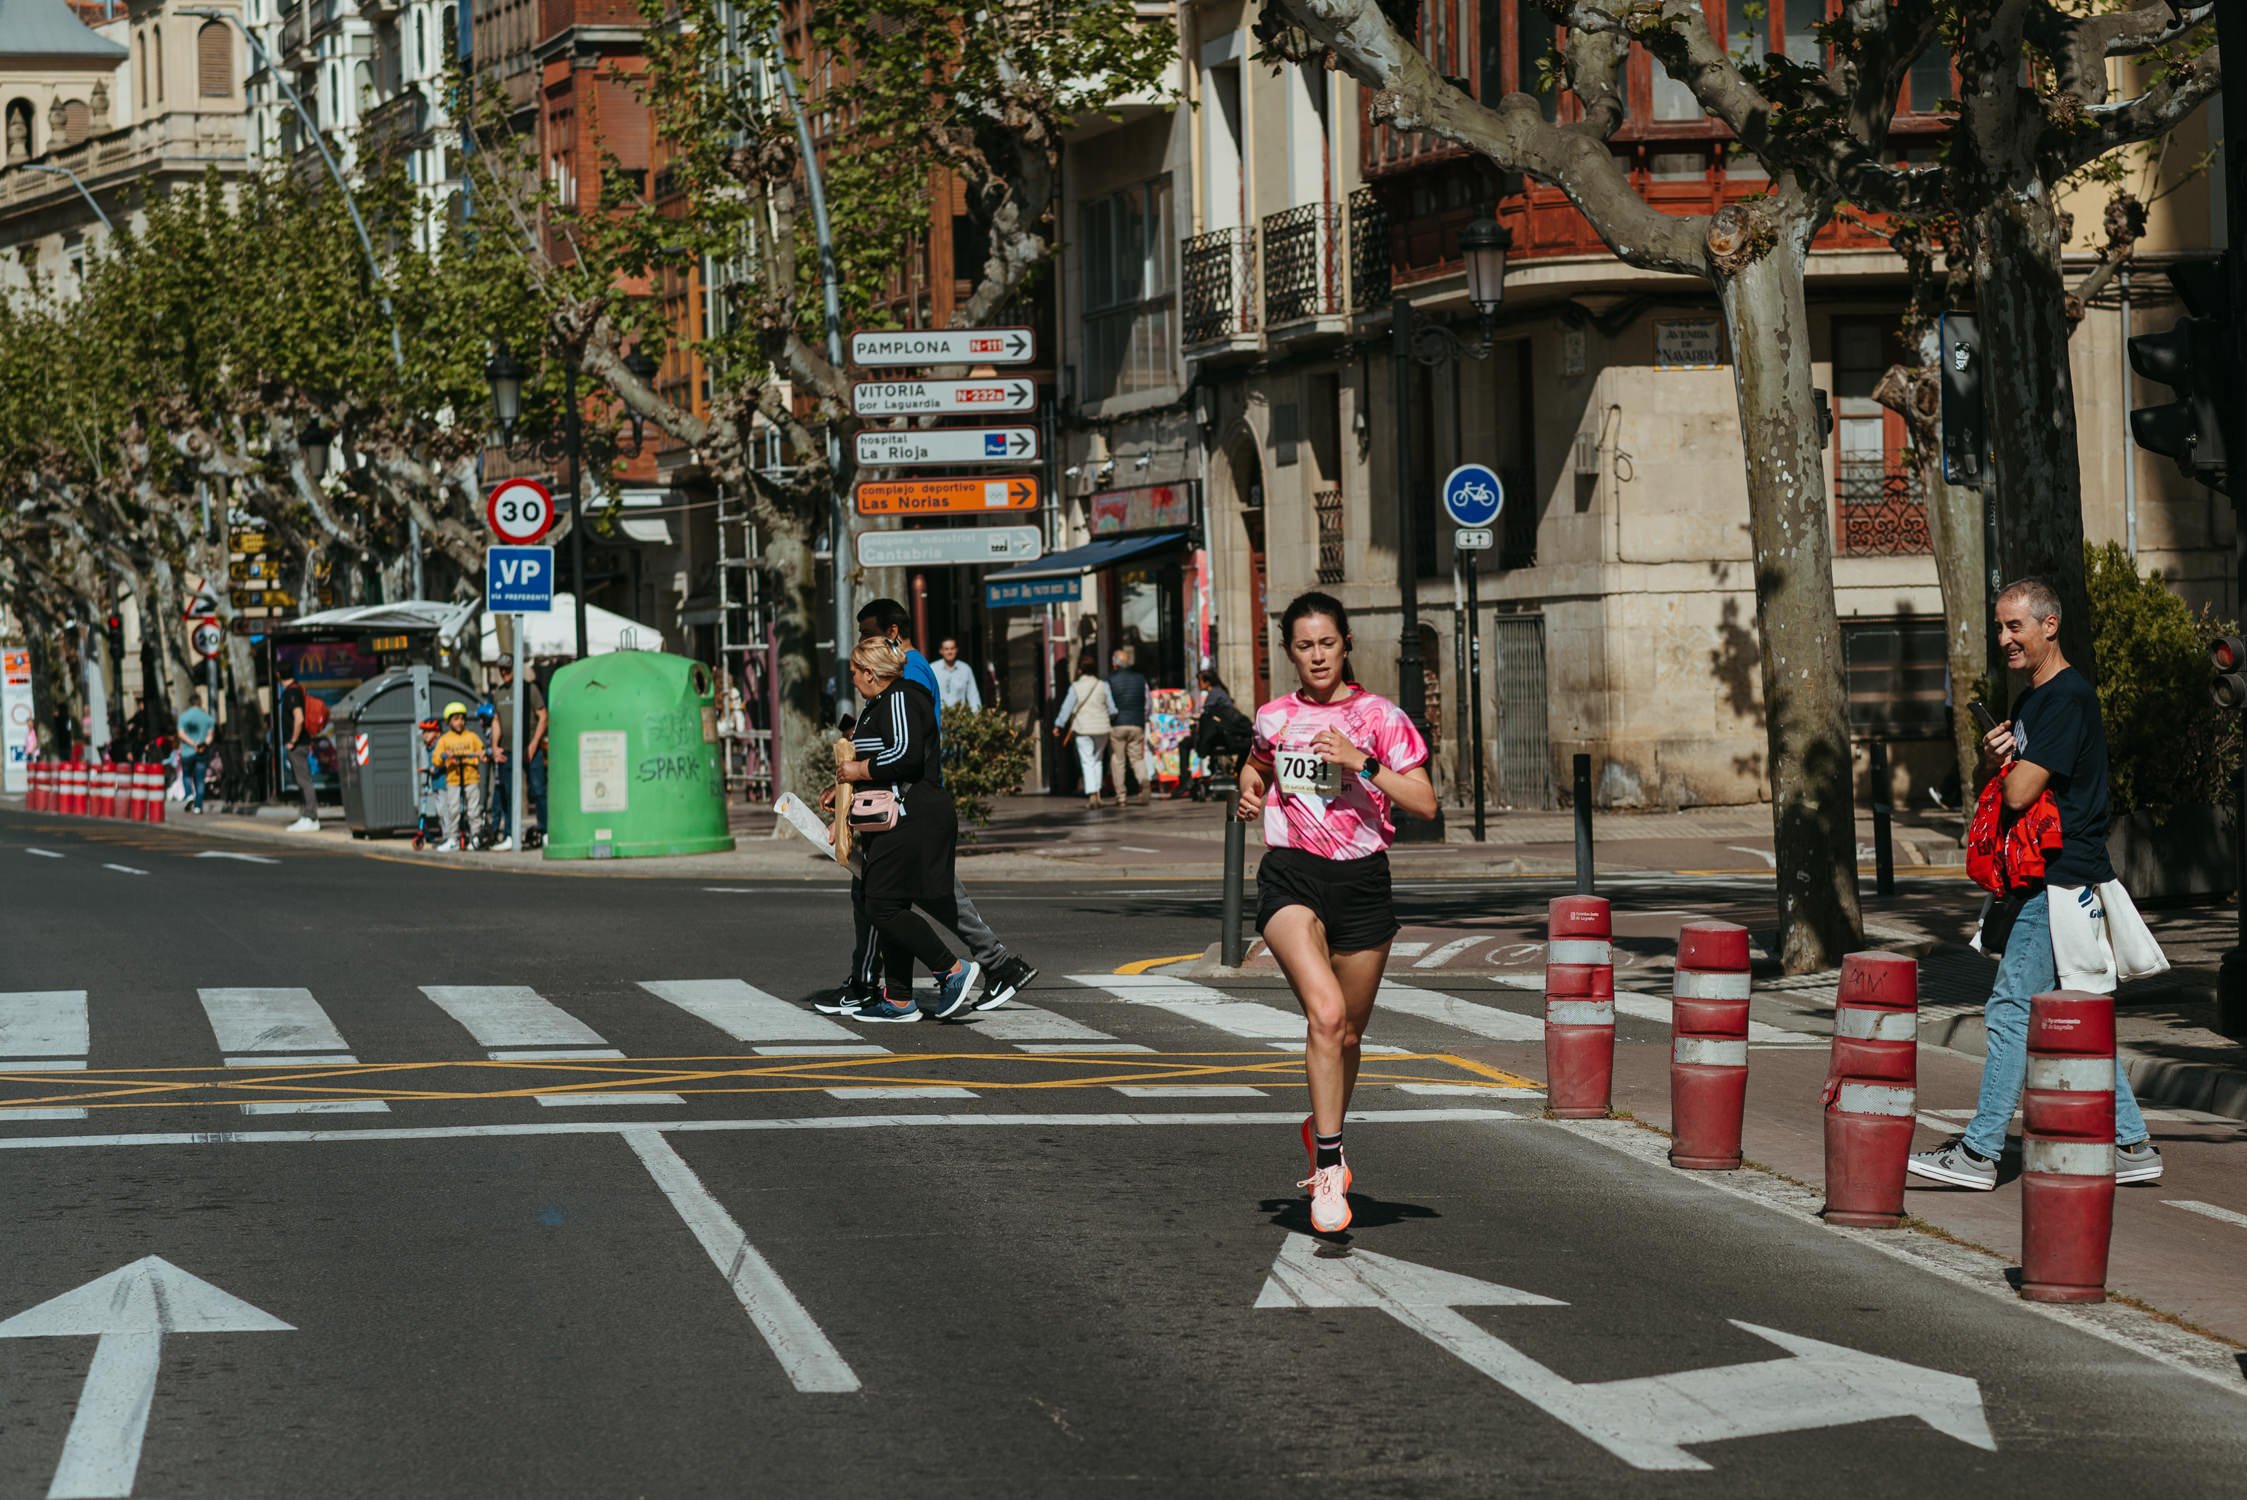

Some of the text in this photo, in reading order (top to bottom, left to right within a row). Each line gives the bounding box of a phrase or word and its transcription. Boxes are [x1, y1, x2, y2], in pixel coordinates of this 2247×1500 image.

[857, 341, 951, 355] PAMPLONA
[971, 339, 1003, 352] N-111
[1662, 348, 1715, 362] NAVARRA
[858, 384, 926, 398] VITORIA
[957, 390, 1004, 402] N-232a
[858, 399, 941, 411] por Laguardia
[860, 434, 908, 446] hospital
[861, 446, 929, 461] La Rioja
[861, 482, 976, 496] complejo deportivo
[861, 496, 950, 510] Las Norias
[502, 501, 540, 522] 30
[920, 533, 977, 544] industrial
[864, 547, 943, 562] Cantabria
[500, 559, 541, 586] VP
[504, 592, 549, 601] PREFERENTE
[1283, 756, 1329, 781] 7031
